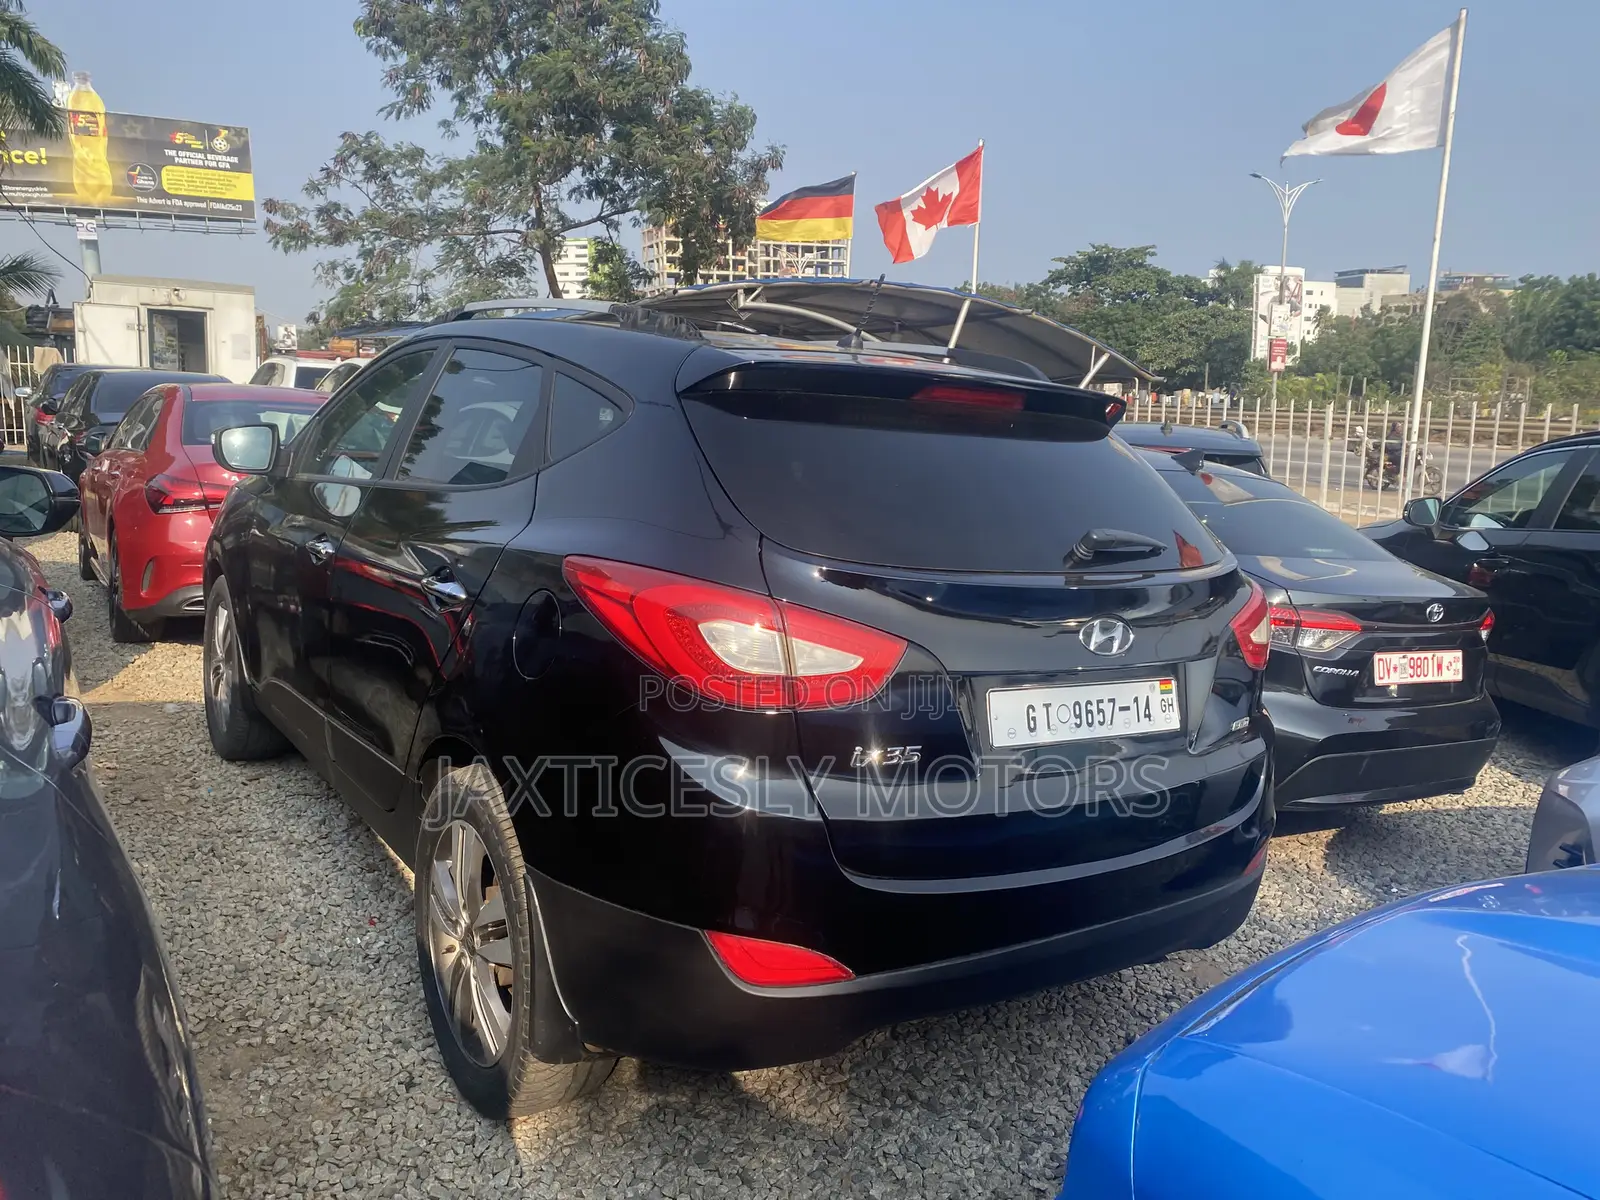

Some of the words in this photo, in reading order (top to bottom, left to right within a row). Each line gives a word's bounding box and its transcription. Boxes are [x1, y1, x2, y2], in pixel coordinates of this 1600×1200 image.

[164, 149, 178, 157] THE
[178, 151, 206, 160] OFFICIAL
[207, 153, 239, 163] BEVERAGE
[174, 157, 204, 167] PARTNER
[136, 196, 147, 204] This
[149, 197, 165, 205] Advert
[172, 199, 183, 207] FDA
[184, 201, 207, 210] approved
[1312, 665, 1360, 677] COROLLA
[1377, 657, 1392, 681] DV
[1026, 702, 1052, 733] GT
[1072, 695, 1152, 730] 9657-14
[1159, 697, 1175, 714] GH
[849, 745, 923, 768] ix35
